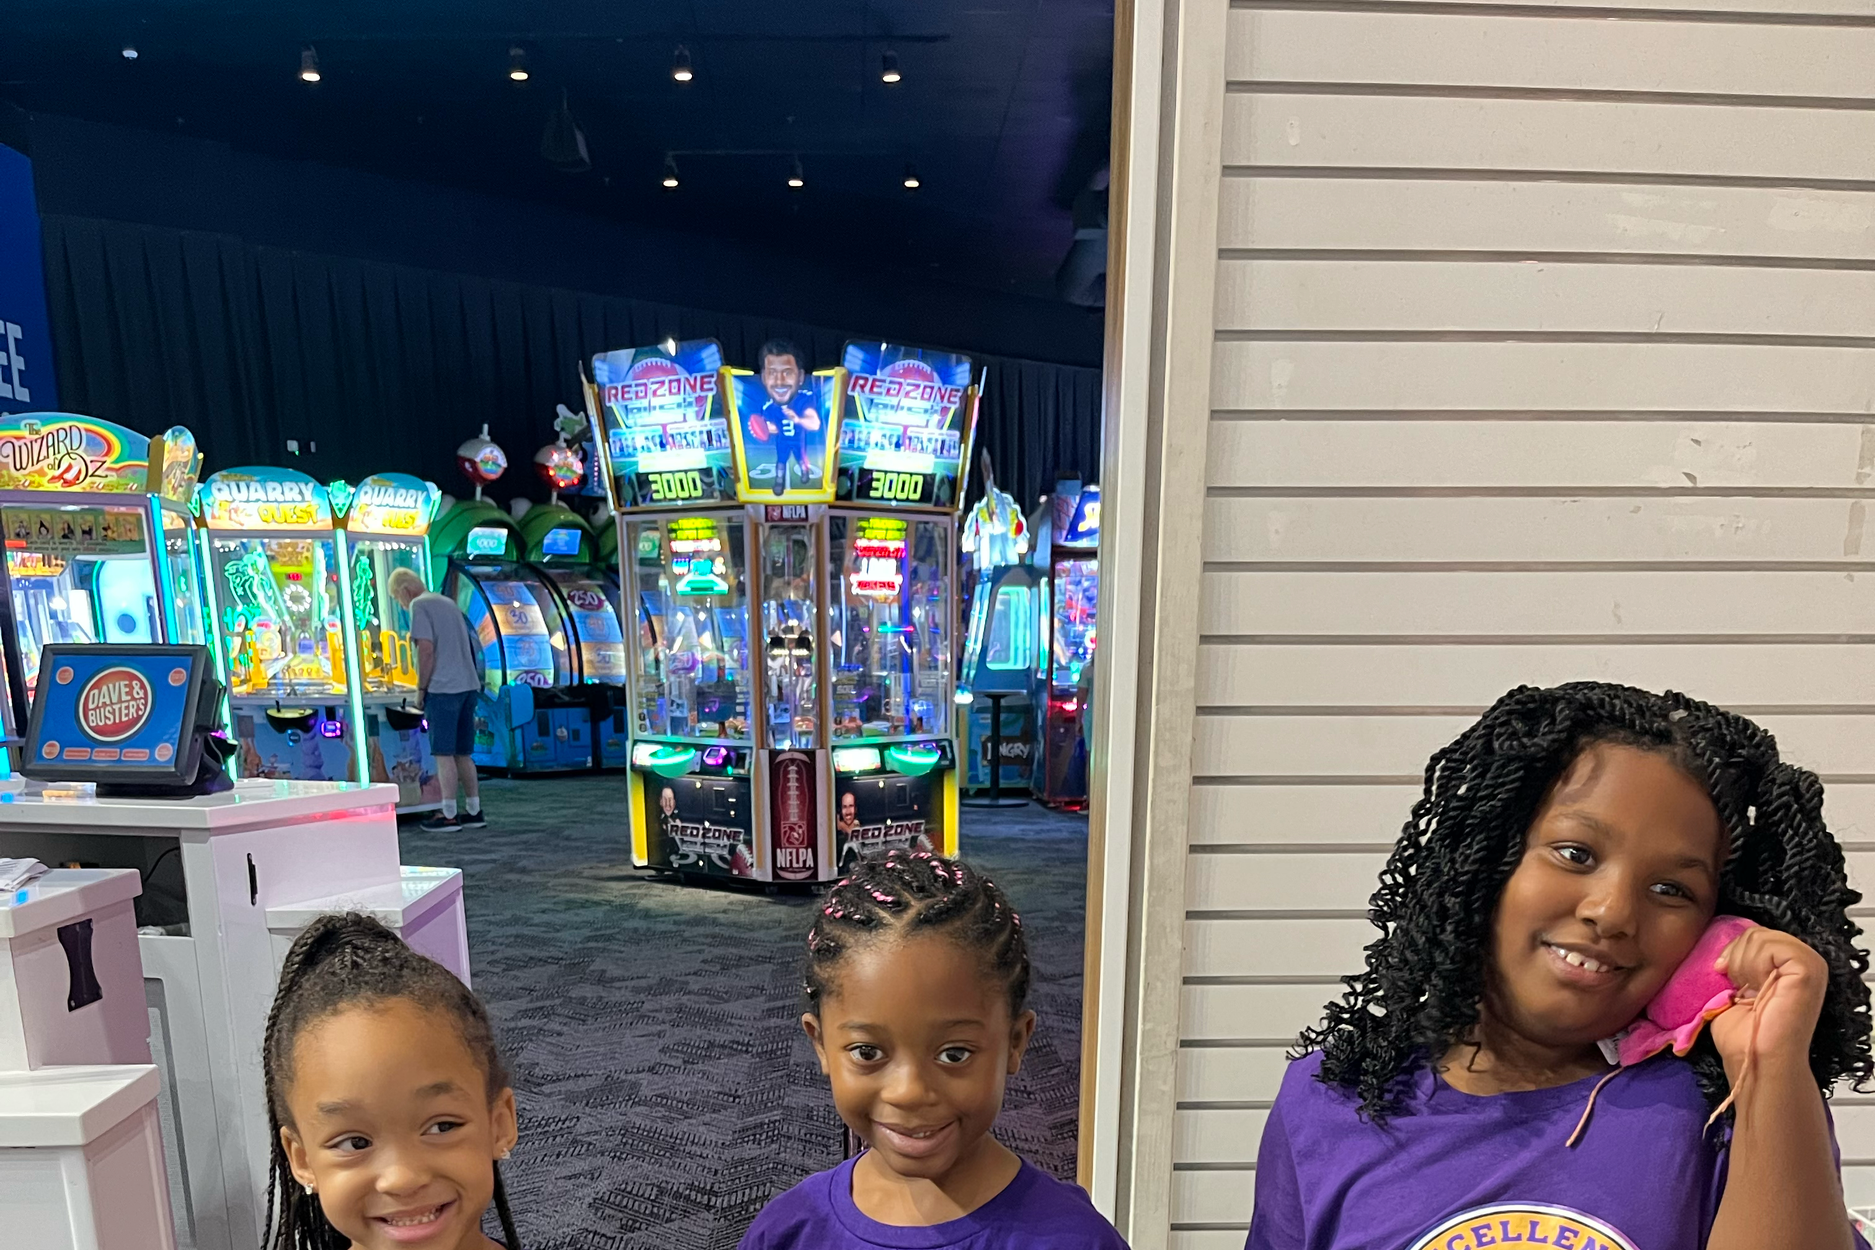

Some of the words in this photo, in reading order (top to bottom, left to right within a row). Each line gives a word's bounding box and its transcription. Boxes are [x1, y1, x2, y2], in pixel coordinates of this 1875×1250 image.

[24, 423, 42, 436] The
[1, 425, 83, 471] WIZARD
[47, 457, 59, 471] of
[211, 481, 314, 503] QUARRY
[649, 471, 702, 500] 3000
[870, 472, 923, 500] 3000
[359, 486, 427, 508] QUARRY
[258, 504, 319, 524] QUEST
[570, 590, 599, 605] 250
[89, 681, 131, 710] DAVE
[132, 680, 145, 698] &
[88, 699, 146, 727] BUSTER'S
[987, 742, 1030, 760] NGRY
[776, 848, 814, 867] NFLPA
